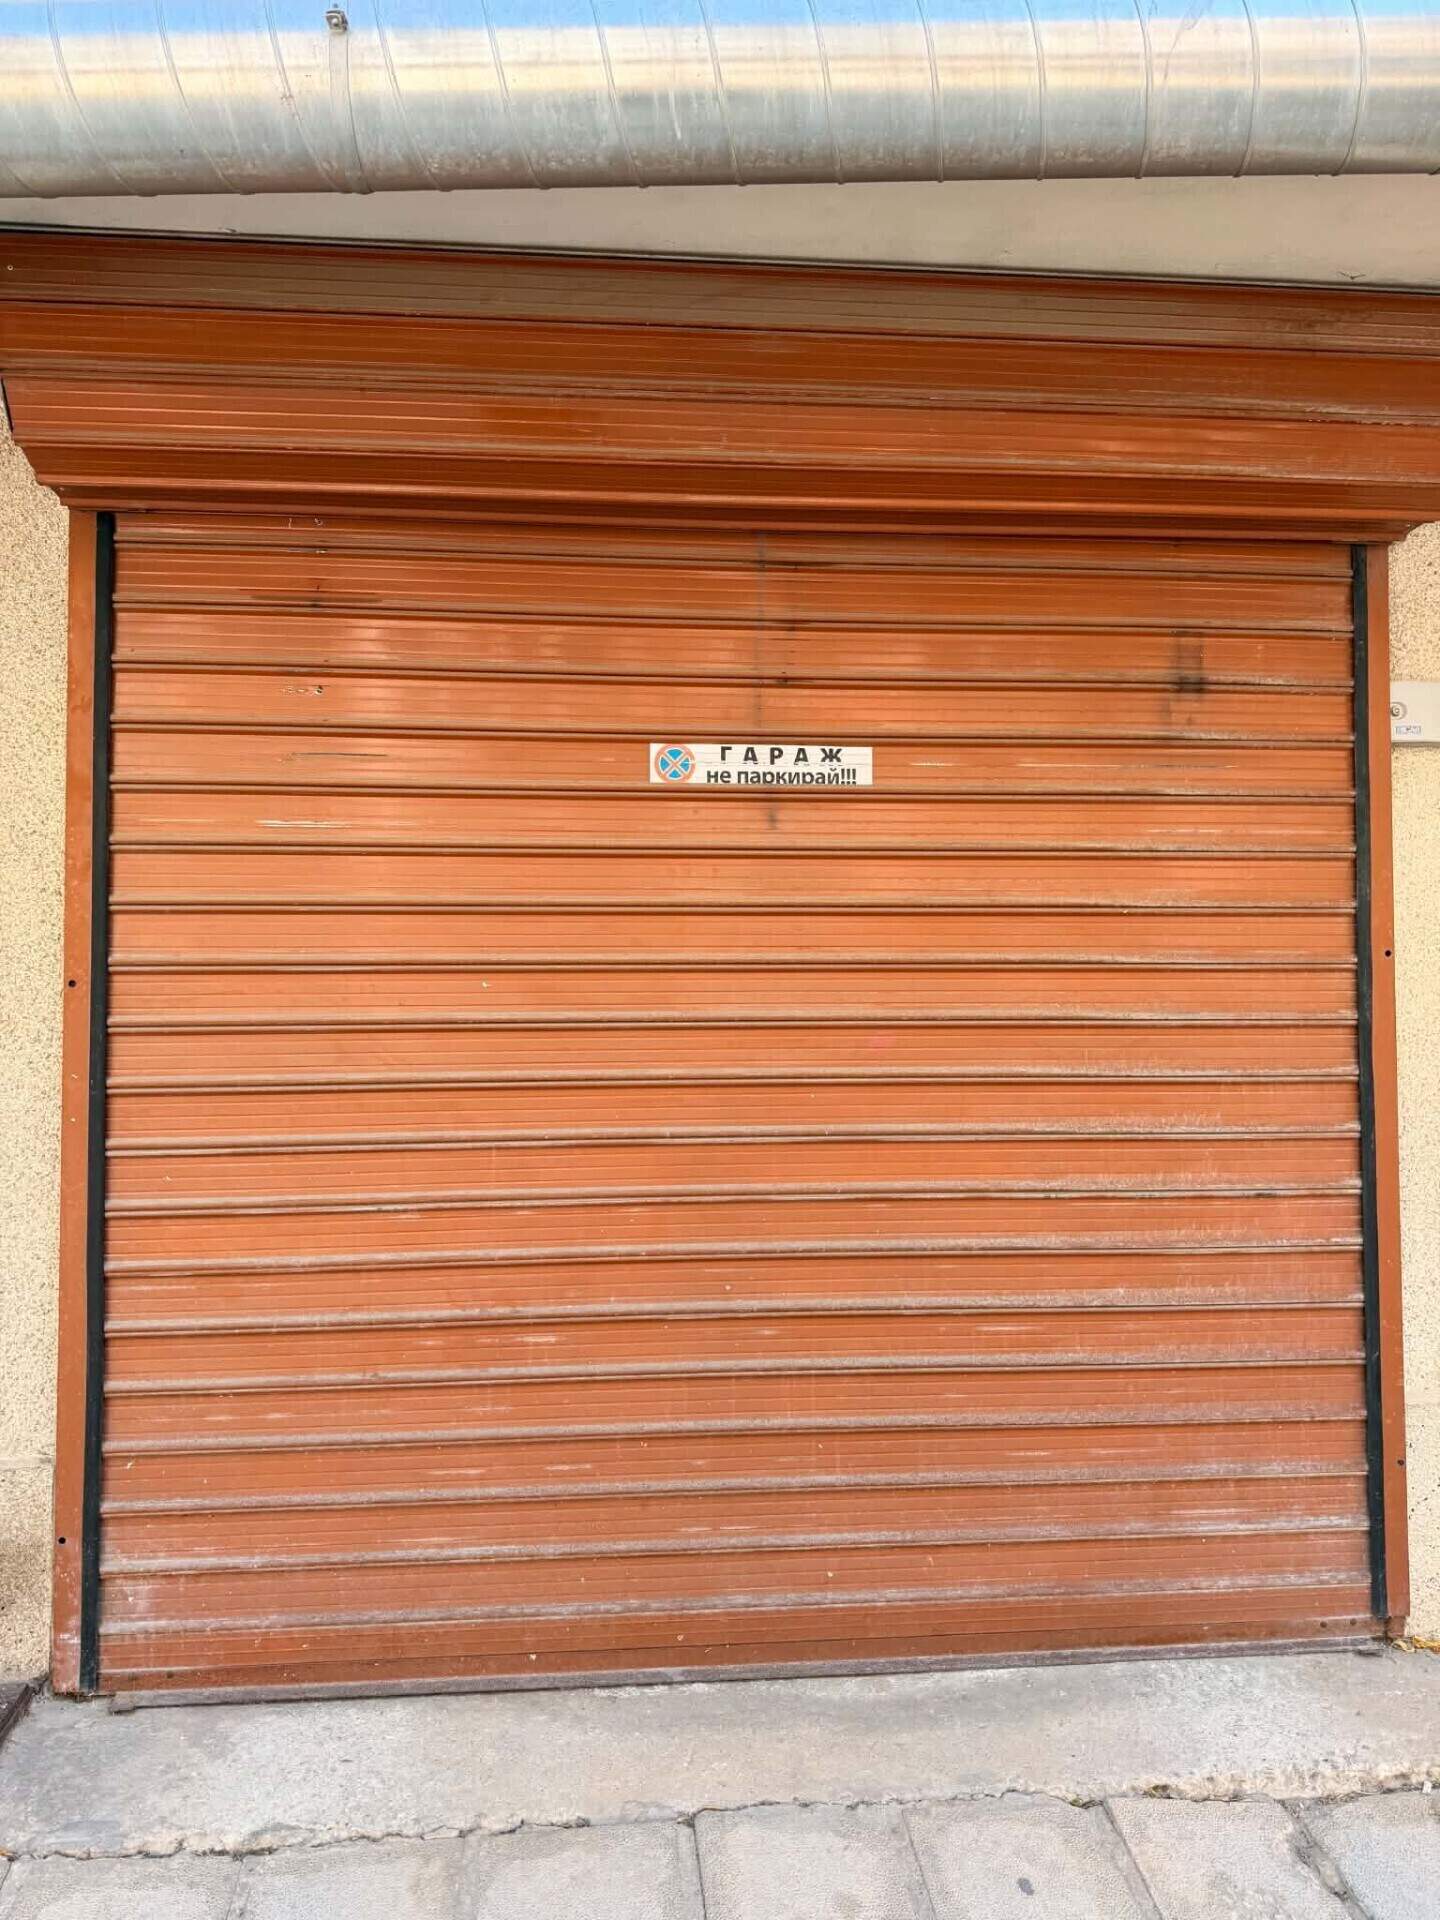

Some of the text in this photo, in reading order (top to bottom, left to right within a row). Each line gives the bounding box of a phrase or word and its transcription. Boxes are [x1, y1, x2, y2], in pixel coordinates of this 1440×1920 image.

[720, 746, 842, 766] ГАРАЖ
[707, 768, 857, 785] не паркирай!!!
